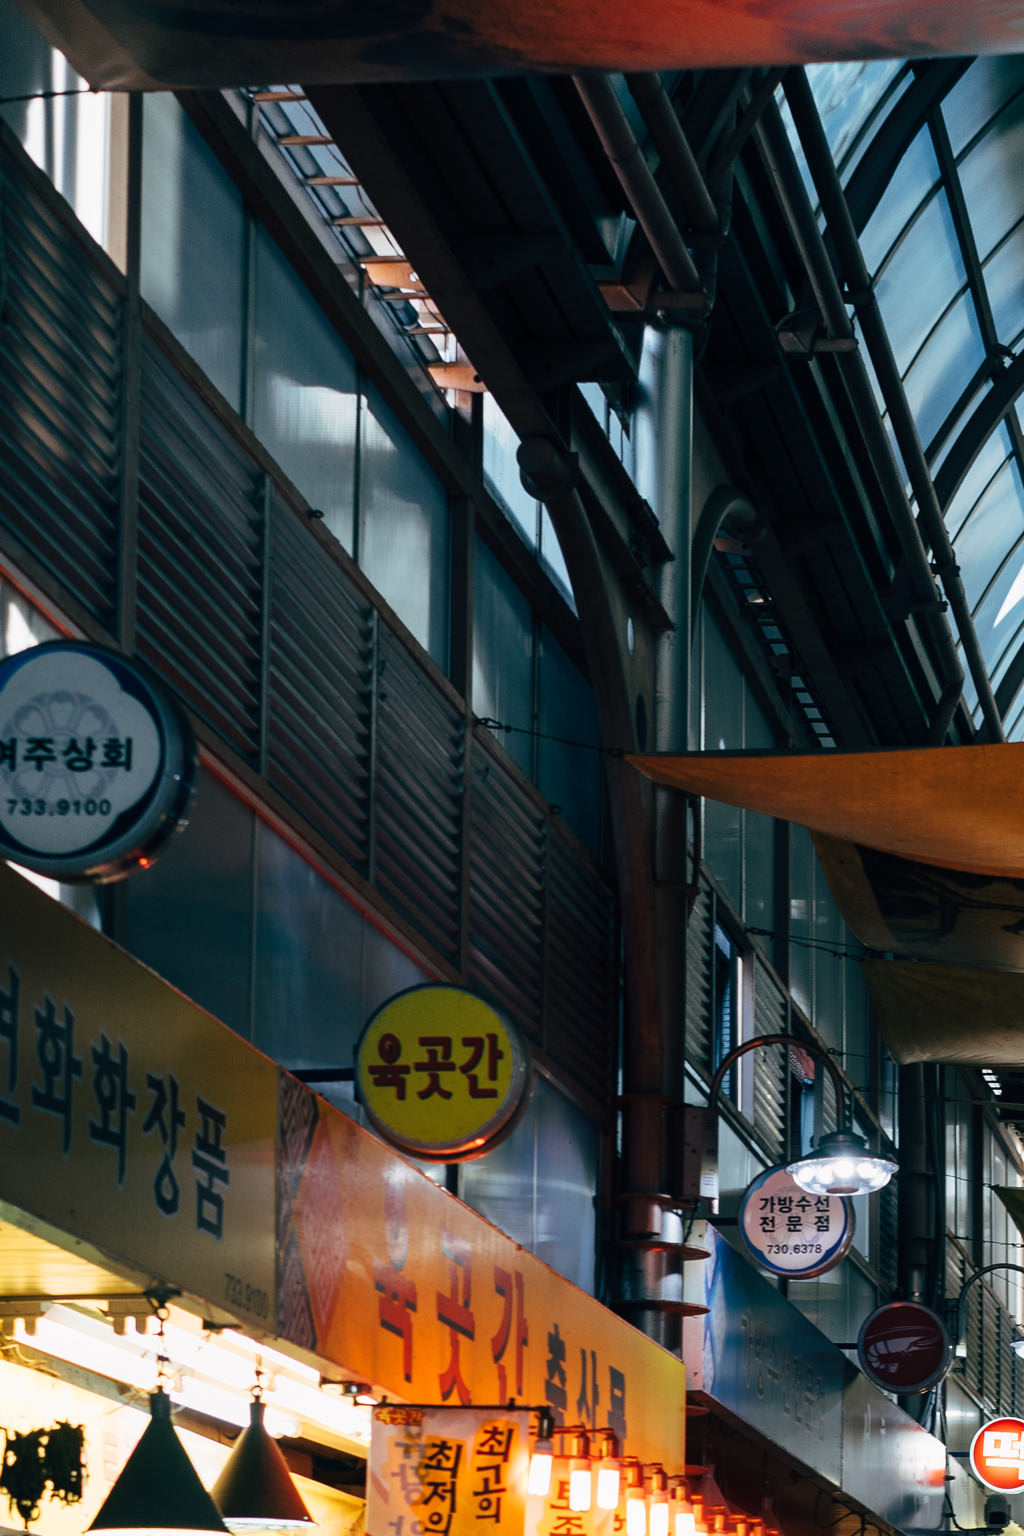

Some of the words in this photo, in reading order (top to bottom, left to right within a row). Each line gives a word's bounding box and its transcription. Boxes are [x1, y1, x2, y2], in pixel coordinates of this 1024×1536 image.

[7, 799, 111, 816] 733.9100
[367, 1033, 504, 1101] 육곳간
[760, 1196, 830, 1213] 가방수선
[760, 1215, 830, 1233] 전문점
[767, 1244, 822, 1255] 730.6378
[473, 1426, 515, 1524] 최고의
